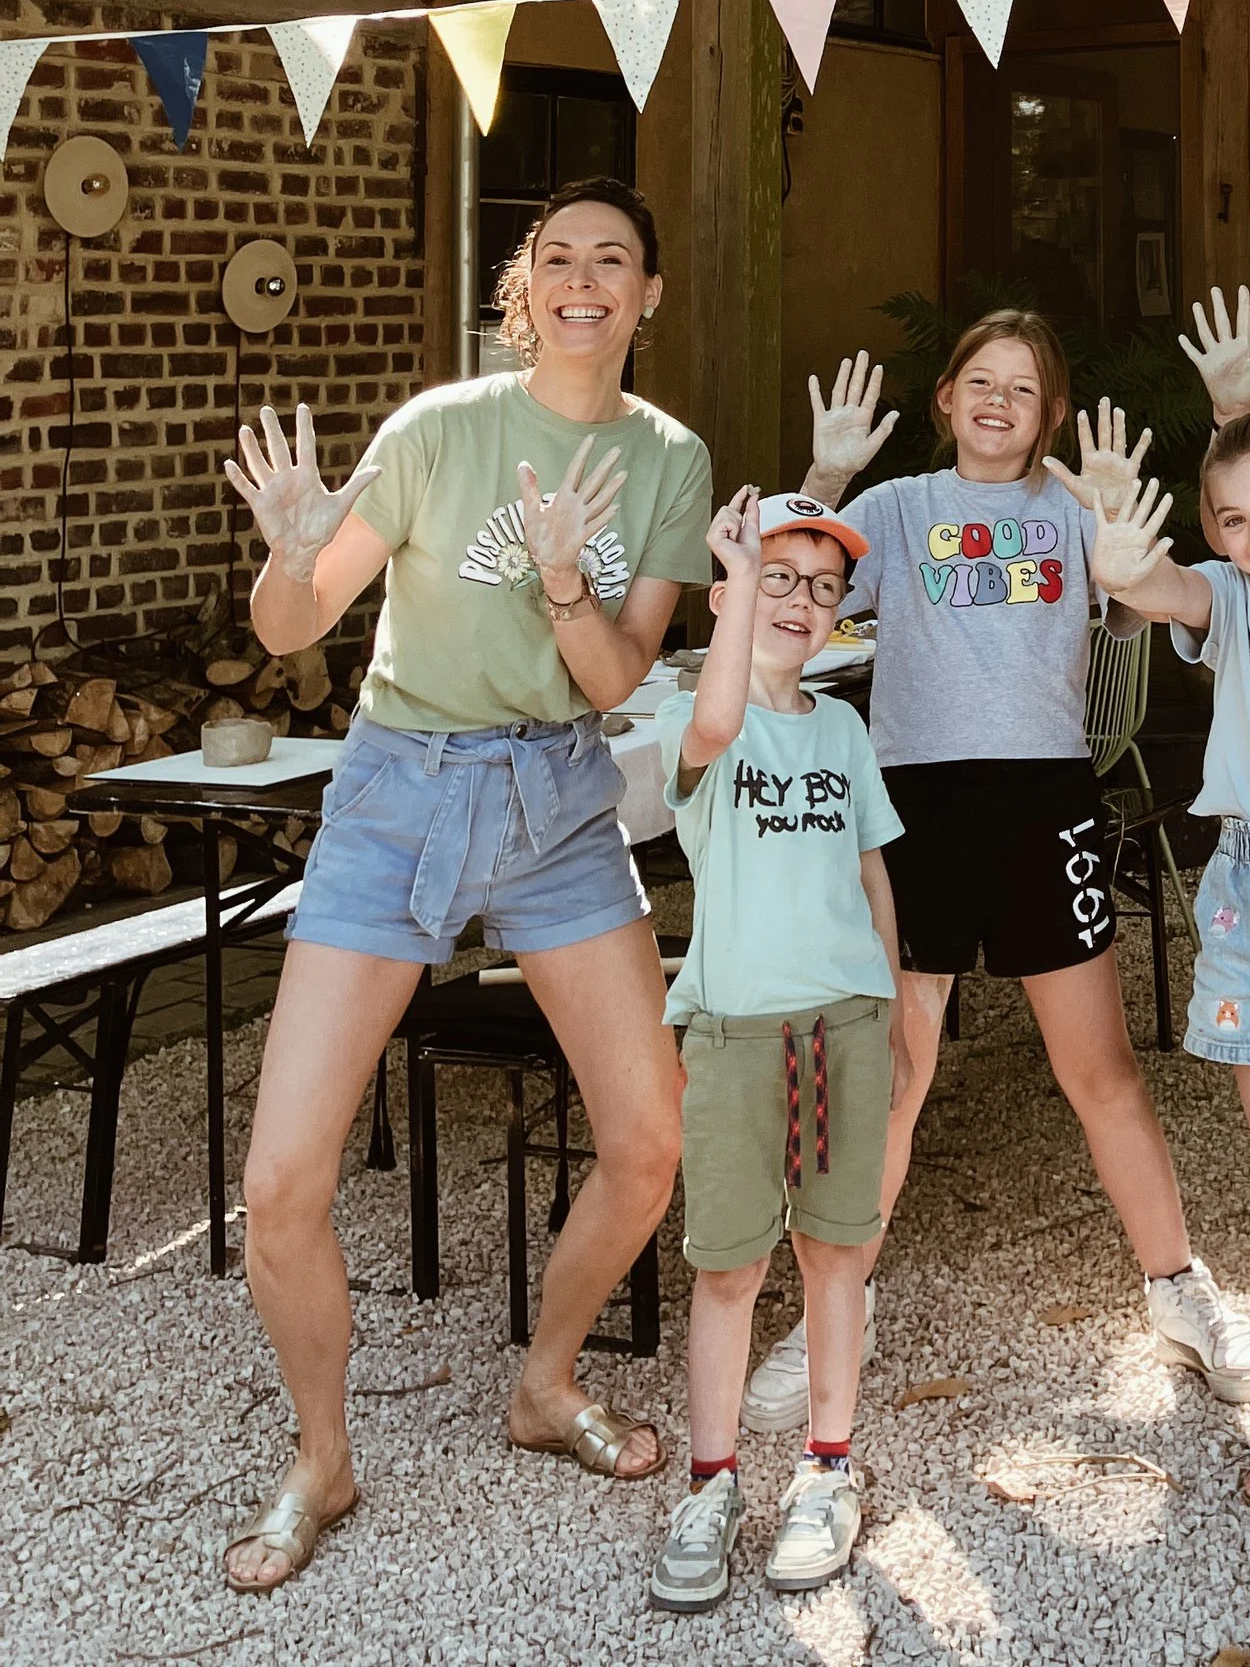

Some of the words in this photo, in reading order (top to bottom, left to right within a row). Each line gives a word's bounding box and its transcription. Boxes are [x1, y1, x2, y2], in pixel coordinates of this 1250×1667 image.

[928, 518, 1058, 561] GOOD
[919, 559, 1063, 607] VIBES
[734, 759, 793, 808] HEY
[800, 769, 850, 809] BOY
[1059, 818, 1110, 949] 1991
